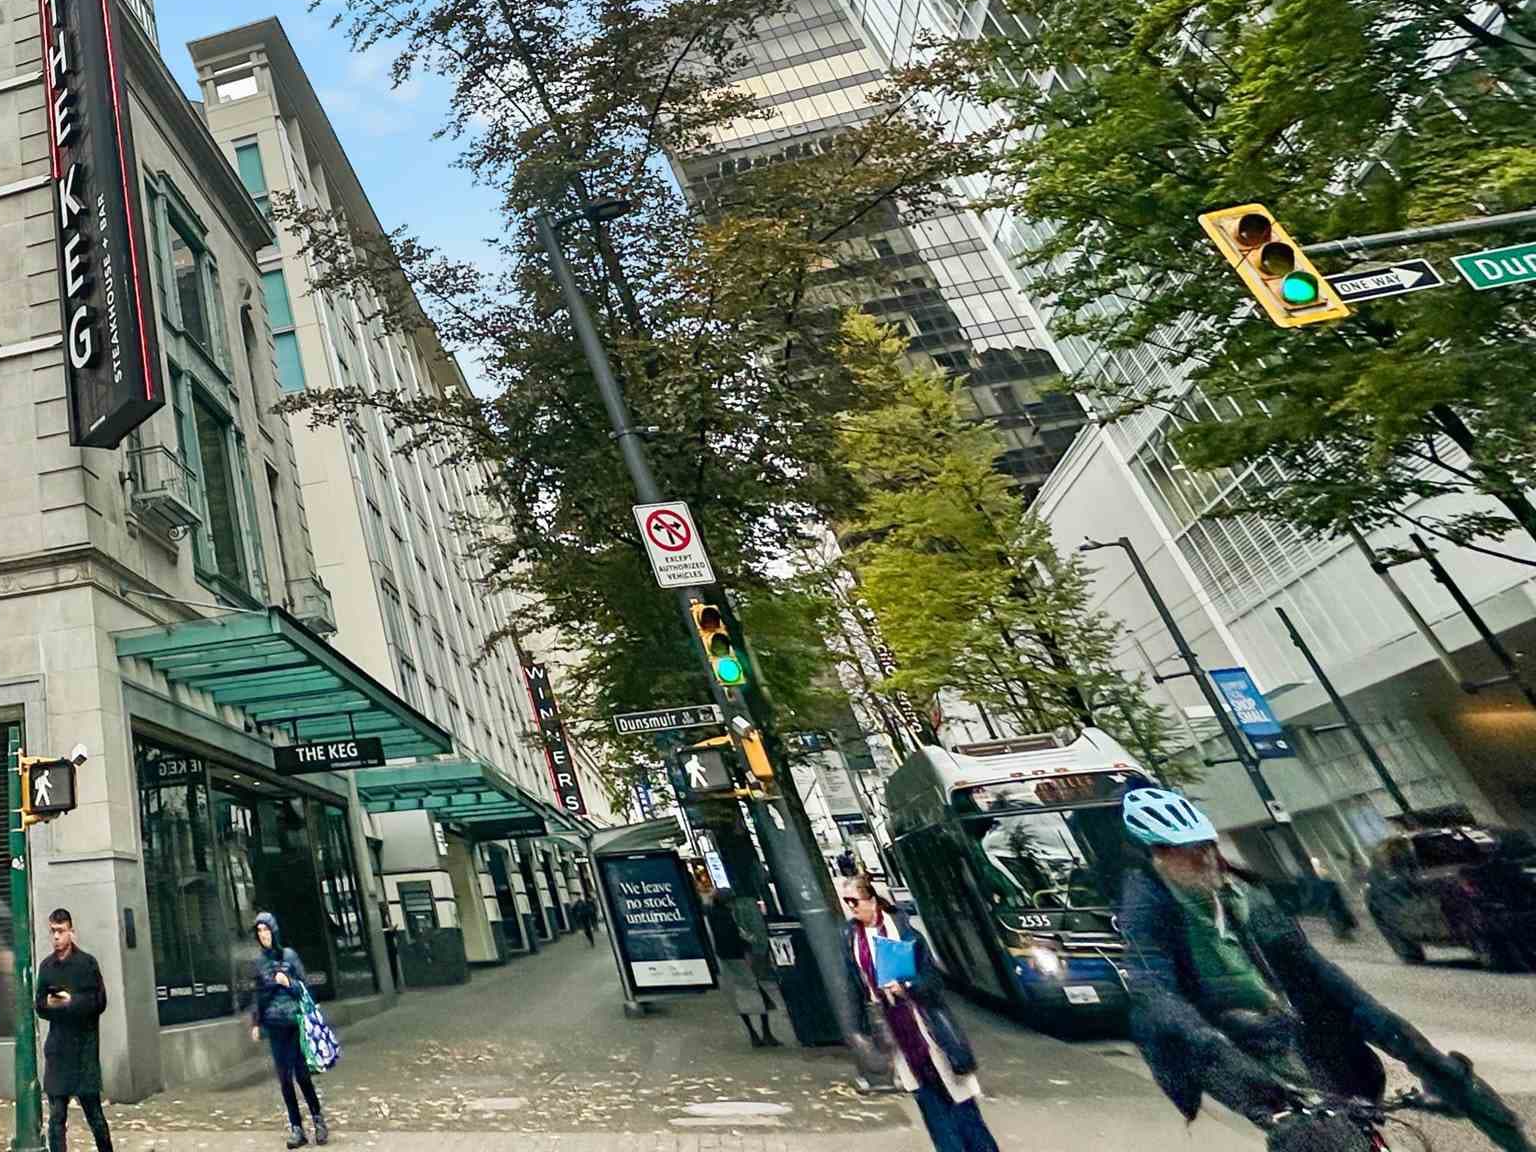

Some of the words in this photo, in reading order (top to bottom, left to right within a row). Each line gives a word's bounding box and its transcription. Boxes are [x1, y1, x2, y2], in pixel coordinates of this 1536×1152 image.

[97, 192, 108, 232] BAR
[59, 163, 92, 369] KEG
[1339, 279, 1368, 293] ONE
[1373, 274, 1401, 288] WAY
[103, 254, 123, 384] STEAKHOUSE
[618, 712, 677, 732] Dunsmuir
[525, 667, 580, 811] WINNERS
[295, 746, 326, 763] THE
[328, 742, 359, 760] KEG
[620, 882, 641, 895] We
[641, 880, 672, 895] leave
[625, 899, 642, 910] no
[644, 893, 676, 909] stock
[1018, 913, 1051, 928] 2535
